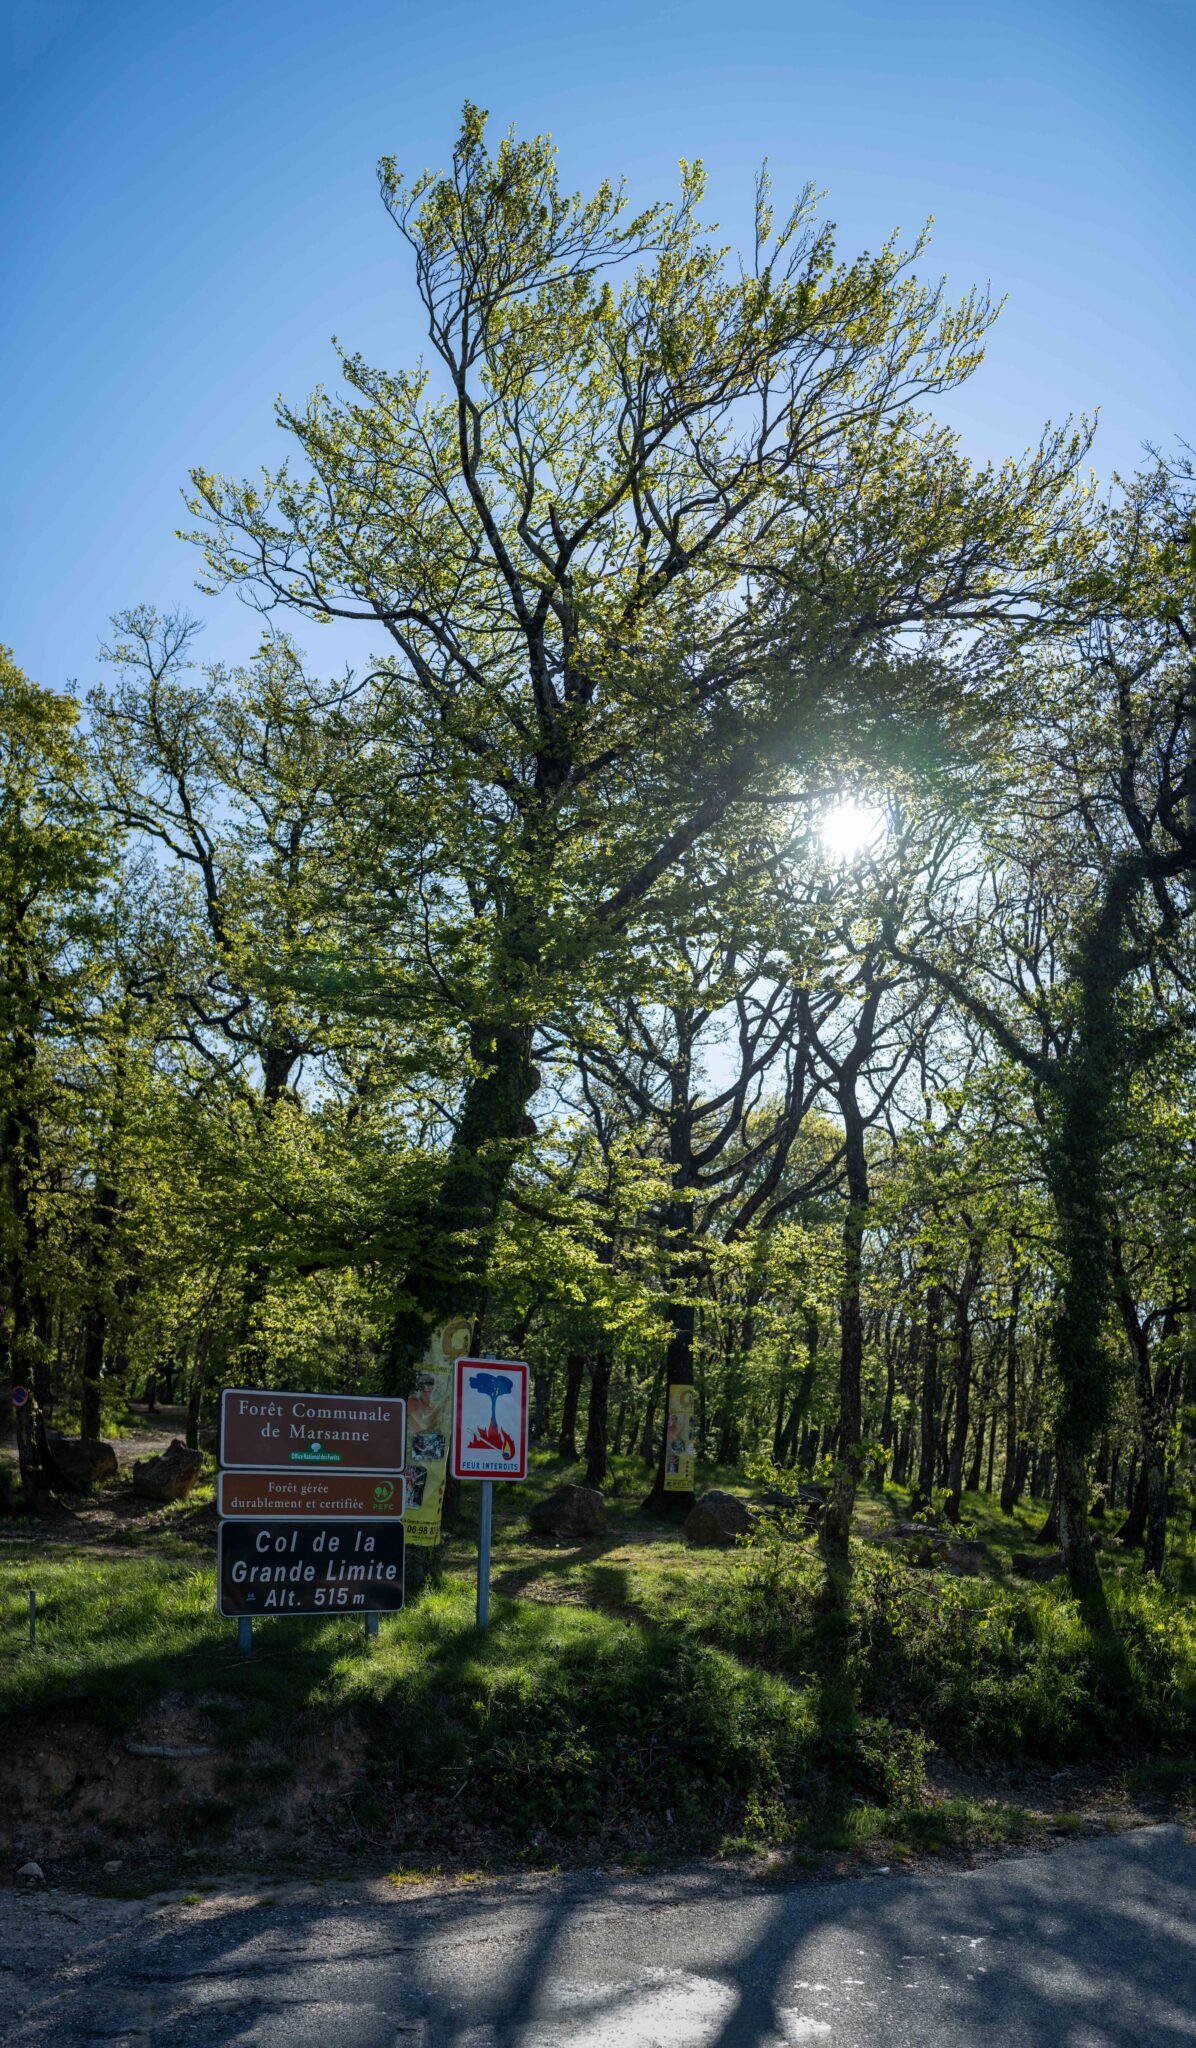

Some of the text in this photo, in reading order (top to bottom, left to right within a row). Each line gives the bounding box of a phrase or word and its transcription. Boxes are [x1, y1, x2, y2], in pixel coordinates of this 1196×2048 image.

[239, 1400, 391, 1422] Forêt Communale
[261, 1422, 370, 1442] de Marsanne
[462, 1461, 518, 1471] FEUX INTERDITS
[268, 1482, 329, 1496] Forêt gérée
[231, 1497, 364, 1510] durablement et certifiée
[372, 1503, 394, 1511] PEFC
[255, 1530, 376, 1553] Col de la
[231, 1559, 397, 1583] Grande Limite
[264, 1589, 301, 1607] Alt.
[314, 1588, 349, 1606] 515
[352, 1592, 365, 1605] m
